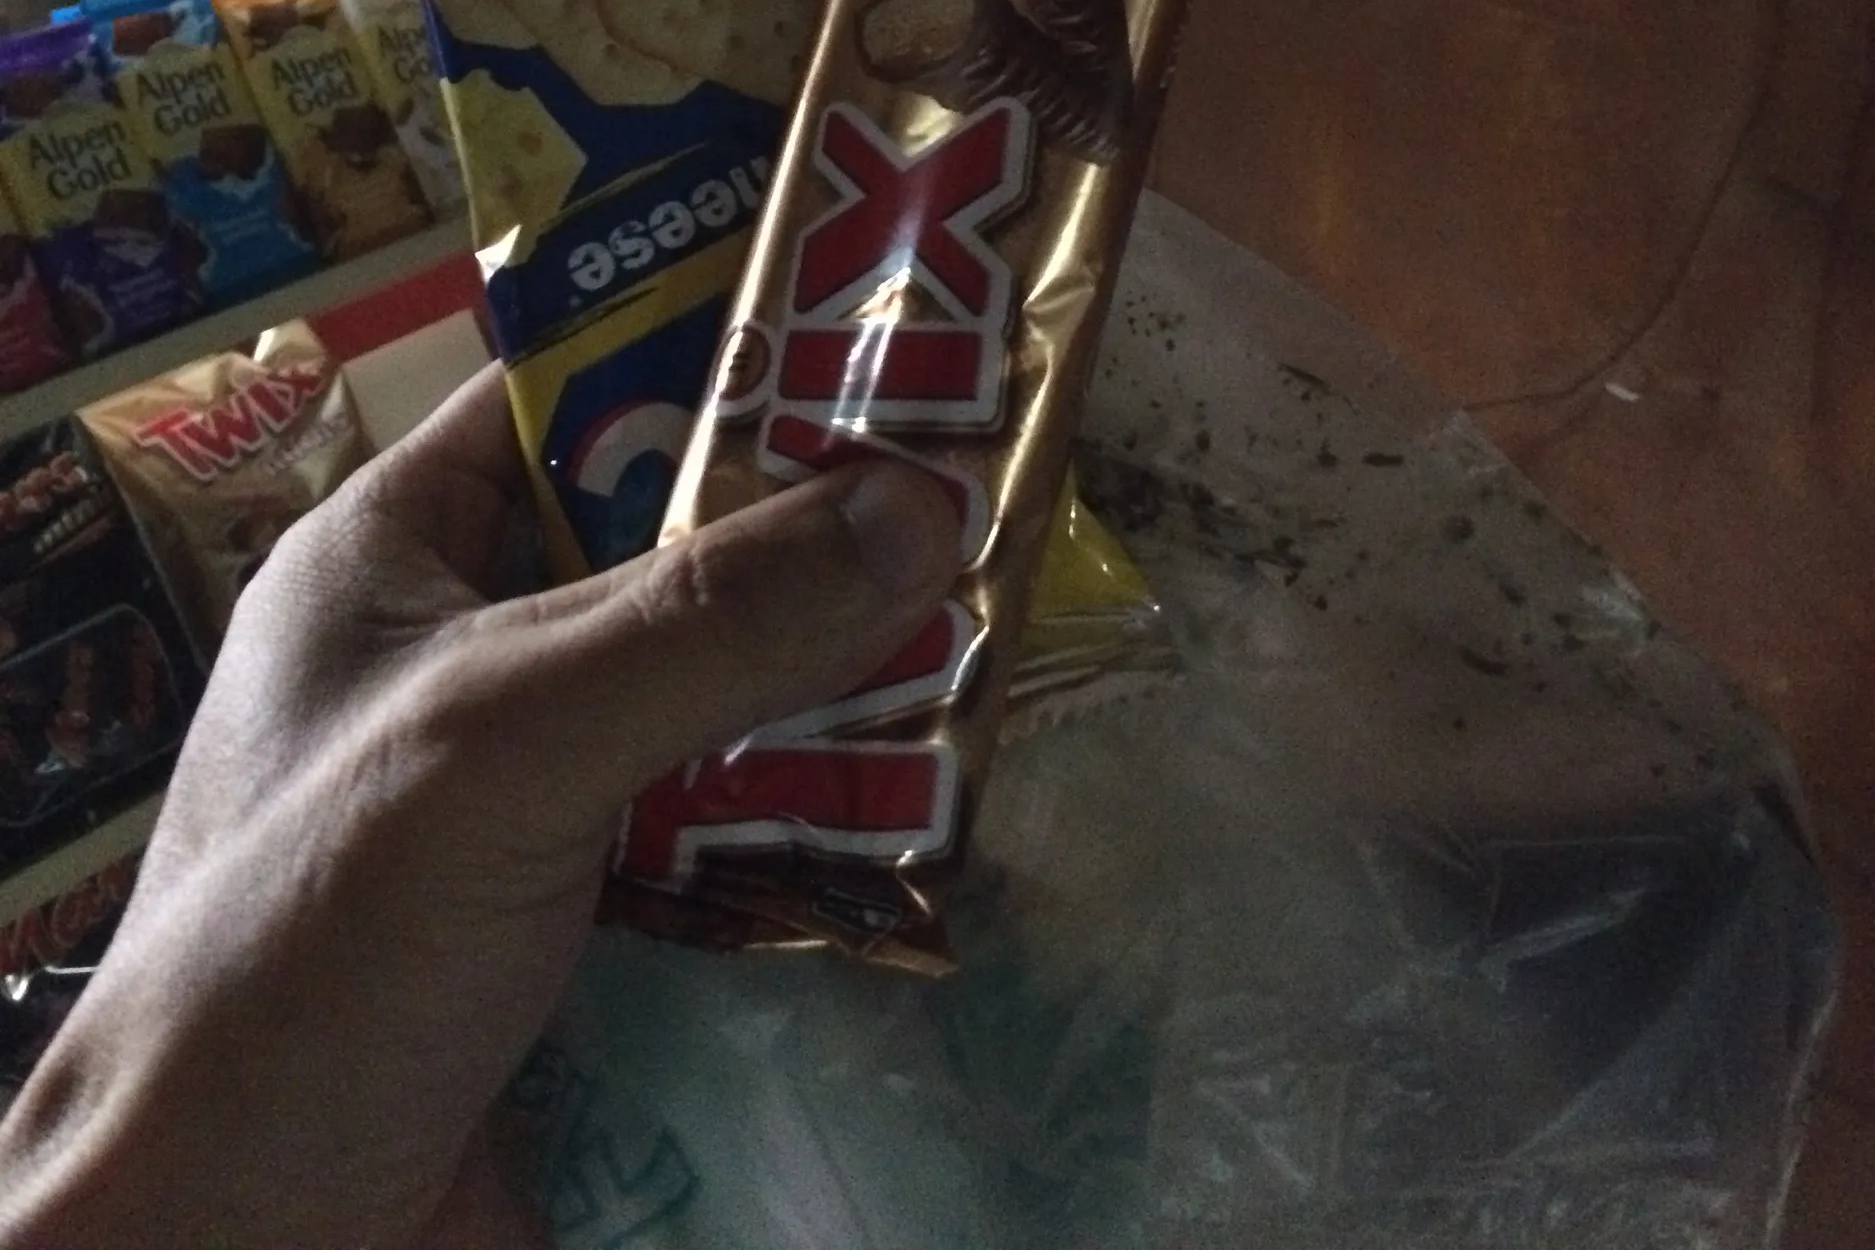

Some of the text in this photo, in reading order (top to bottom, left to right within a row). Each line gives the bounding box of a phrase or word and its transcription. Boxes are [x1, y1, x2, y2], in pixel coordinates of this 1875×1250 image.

[135, 55, 228, 106] Alpen
[268, 45, 353, 92] Alpen
[153, 86, 232, 136] Gold
[286, 77, 358, 120] Gold
[28, 116, 128, 171] Alpen
[46, 157, 133, 201] Gold
